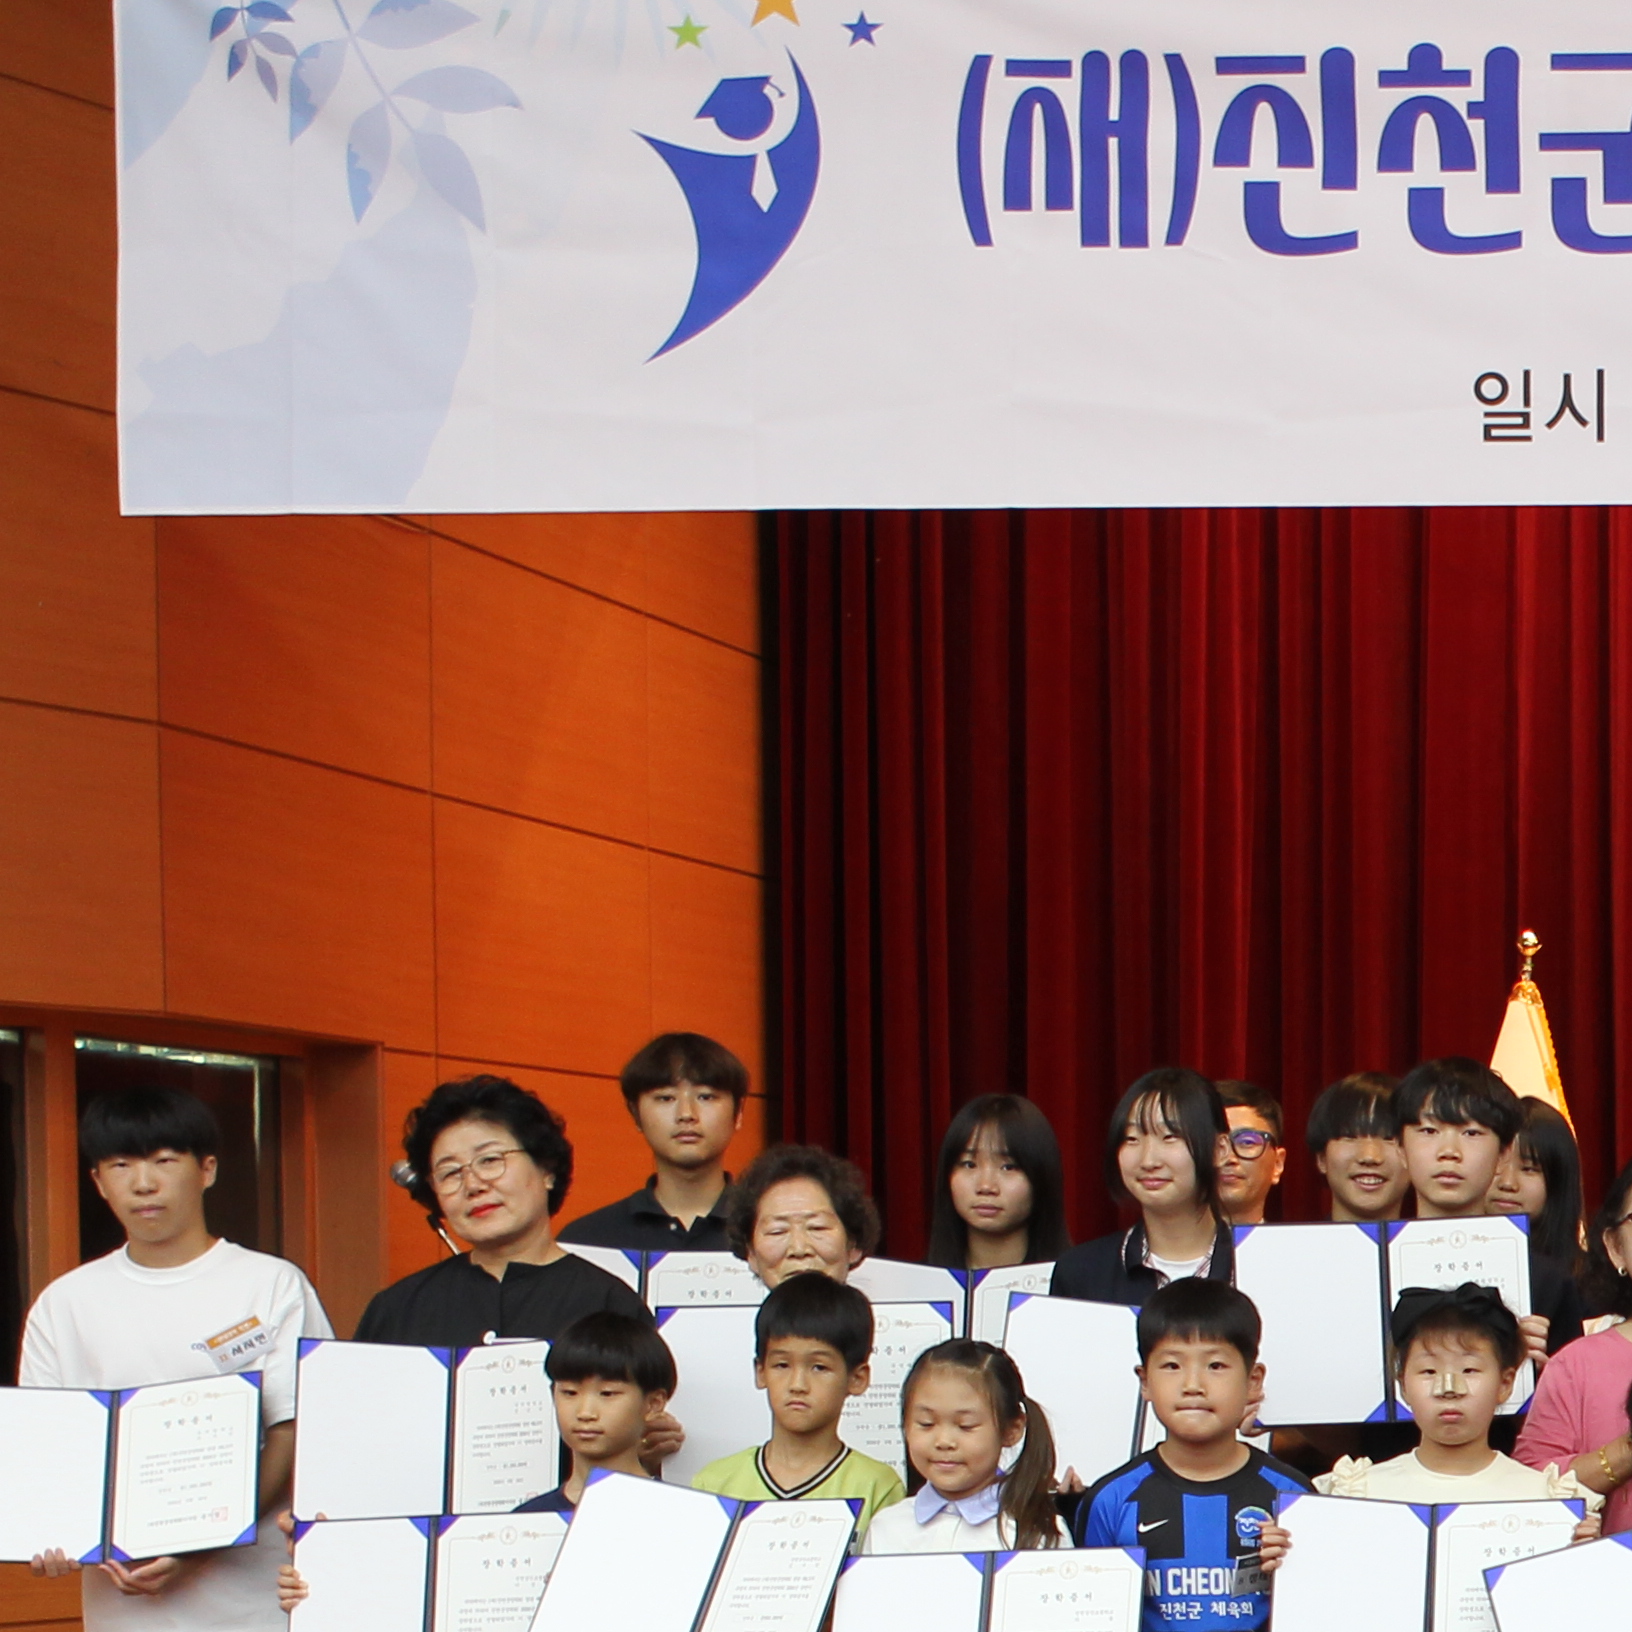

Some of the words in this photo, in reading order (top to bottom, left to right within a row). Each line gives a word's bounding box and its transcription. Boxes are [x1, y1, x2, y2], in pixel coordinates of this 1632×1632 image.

[1472, 368, 1606, 442] 일시
[1159, 1601, 1204, 1621] 진천군
[1210, 1600, 1255, 1620] 체육회
